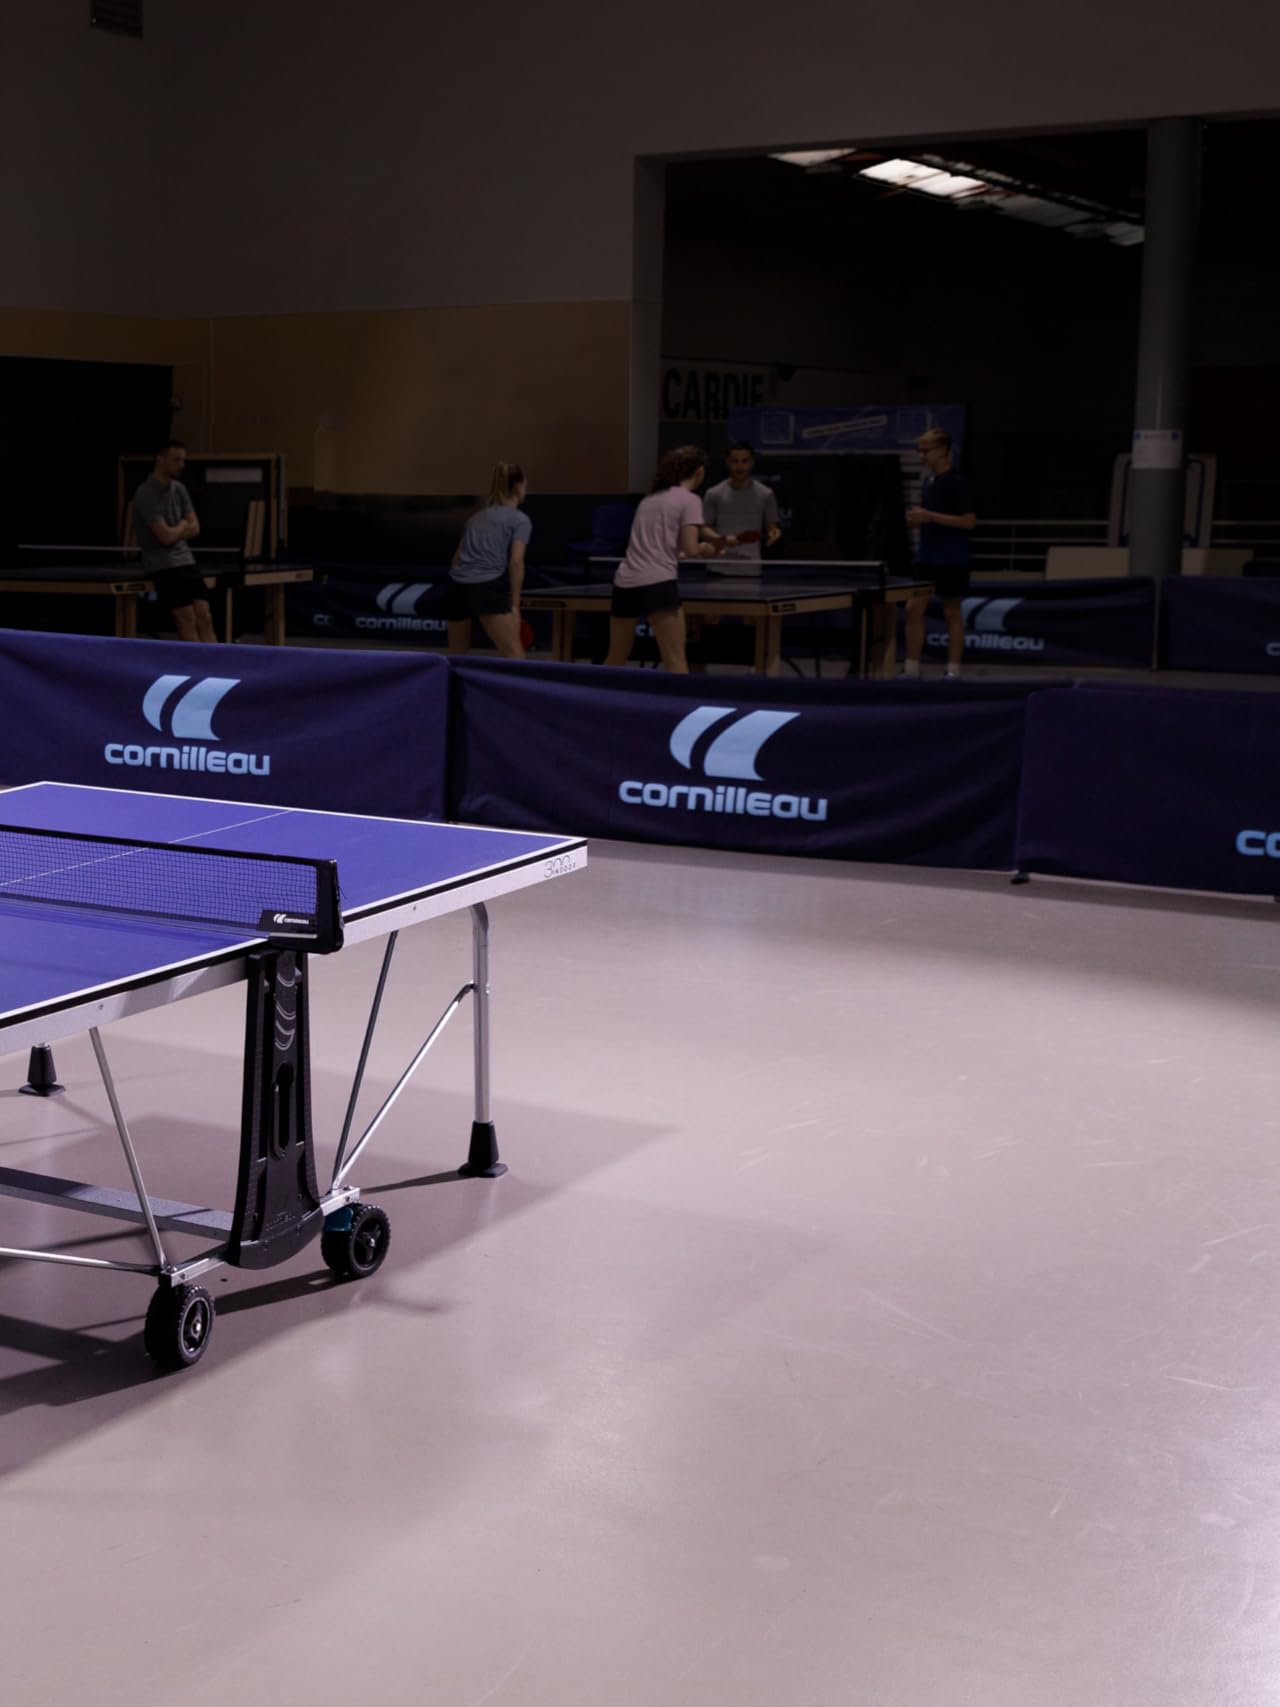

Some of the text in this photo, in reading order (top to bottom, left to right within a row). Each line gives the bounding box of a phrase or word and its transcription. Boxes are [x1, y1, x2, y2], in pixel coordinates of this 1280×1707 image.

[926, 632, 1045, 651] conilleau
[104, 743, 271, 776] cornilleau
[618, 780, 829, 822] cornilleau
